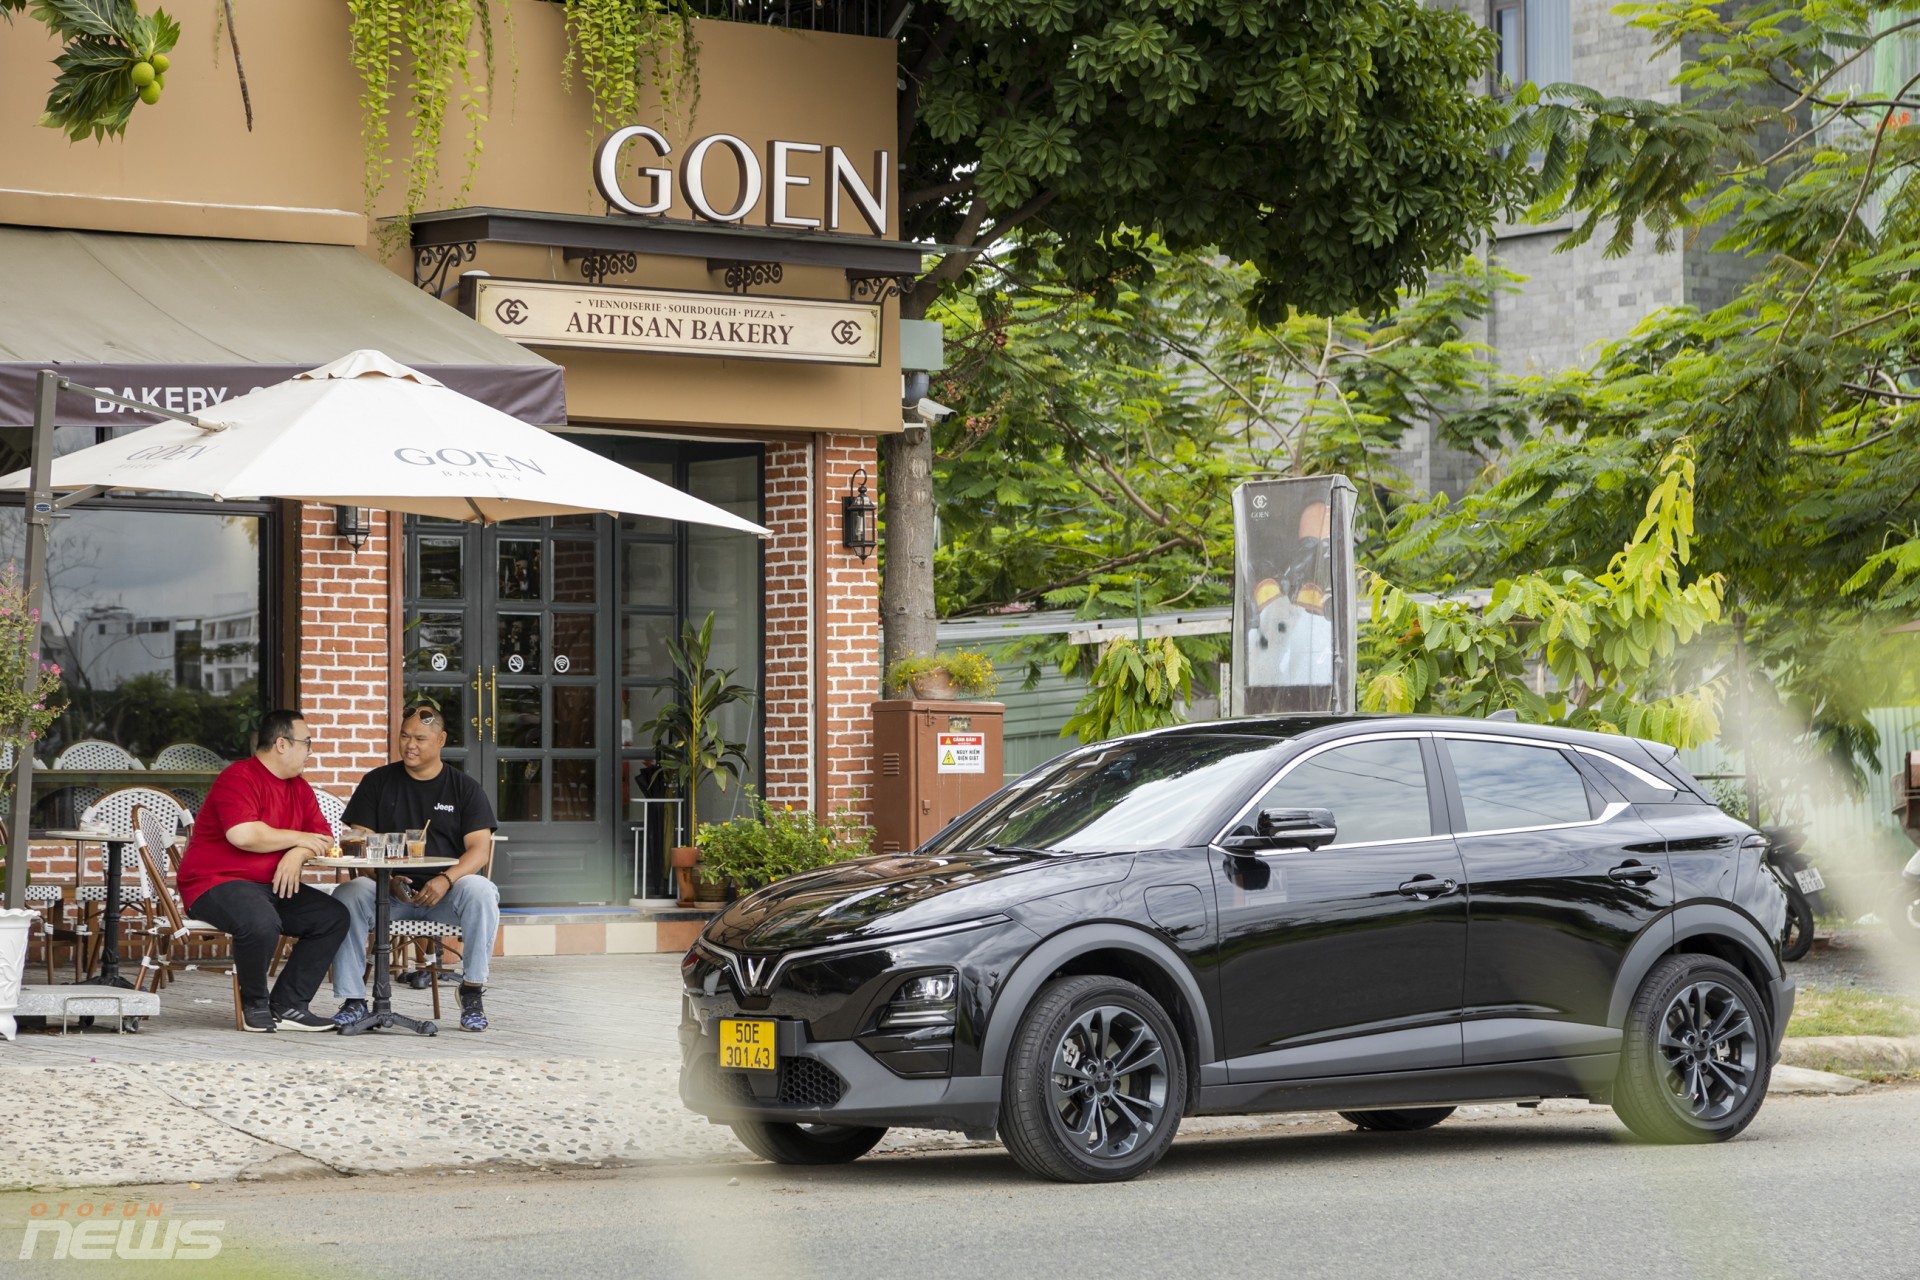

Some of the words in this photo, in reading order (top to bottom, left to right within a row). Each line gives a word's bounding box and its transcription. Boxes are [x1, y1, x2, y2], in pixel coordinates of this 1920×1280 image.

[593, 125, 888, 236] GOEN
[588, 299, 662, 312] VIENNOISERIE
[668, 304, 737, 317] SOURDOUGH
[744, 309, 774, 319] PIZZA
[565, 311, 683, 339] ARTISAN
[691, 319, 794, 345] BAKERY
[94, 386, 228, 414] BAKERY
[394, 448, 546, 476] GOEN
[434, 803, 454, 812] Jeep
[736, 1023, 759, 1043] 50E
[726, 1046, 770, 1068] 301.43
